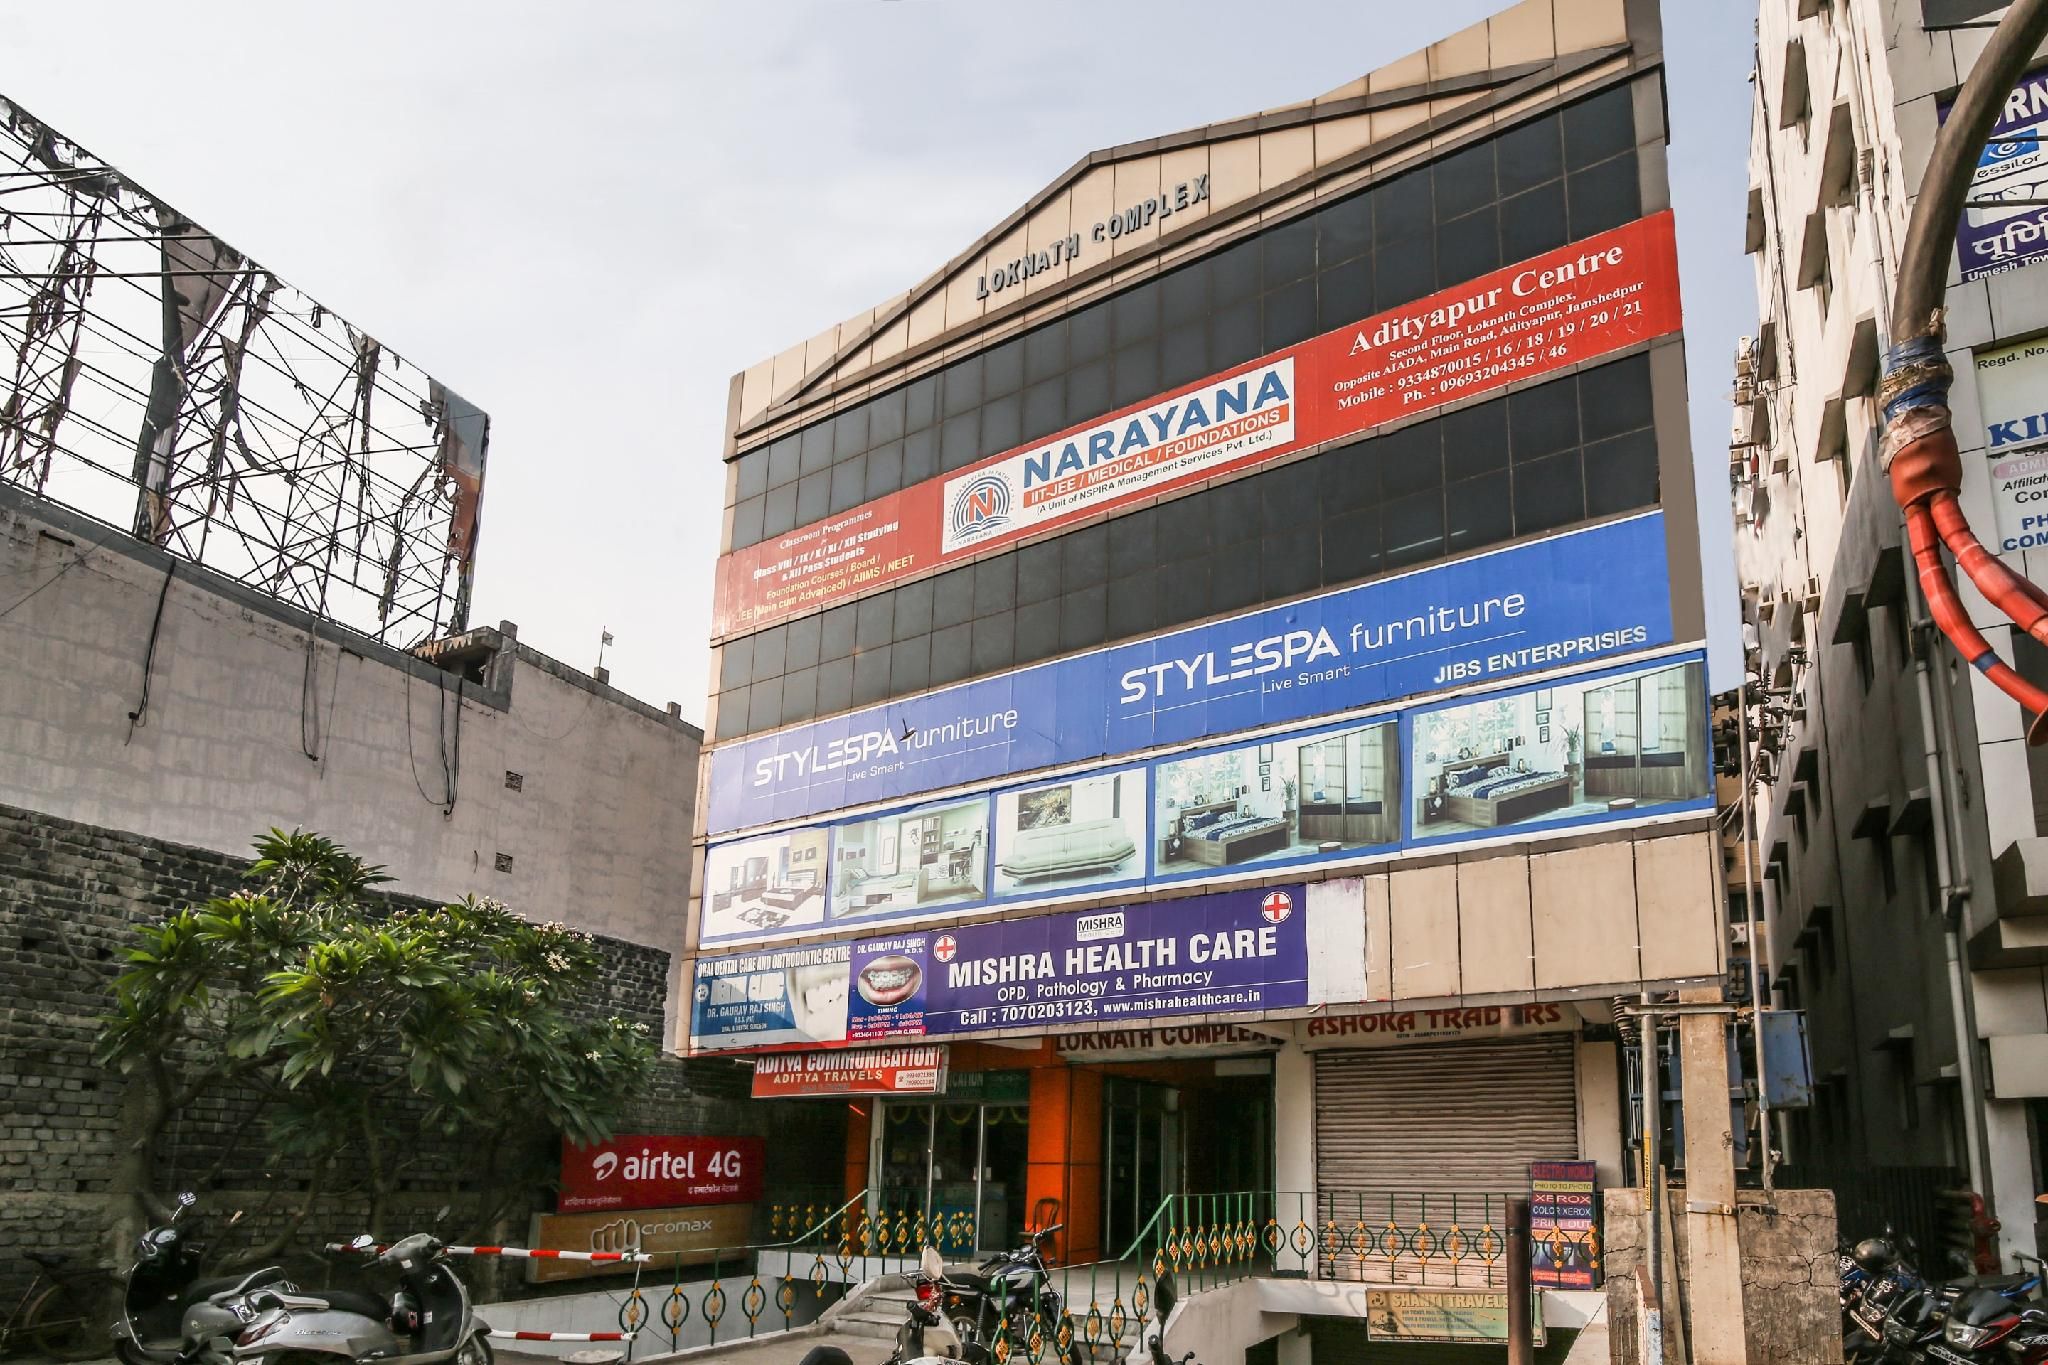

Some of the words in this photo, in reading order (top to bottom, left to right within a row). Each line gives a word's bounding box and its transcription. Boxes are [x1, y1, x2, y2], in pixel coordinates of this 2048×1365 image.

[1977, 153, 2041, 179] essilor
[976, 233, 1079, 300] LOKNATH
[1091, 173, 1209, 243] COMPLEX
[1967, 260, 2018, 282] Umesh
[1348, 286, 1503, 357] Adityapur
[1510, 244, 1624, 298] Centre
[1333, 369, 1381, 393] Opposite
[1430, 342, 1460, 359] Main
[1462, 331, 1498, 350] Road,
[1499, 310, 1563, 339] Adityapur,
[1565, 281, 1645, 315] Jamshedpur
[1389, 340, 1428, 361] Second
[1431, 330, 1464, 347] Floor,
[1467, 312, 1516, 335] Loknath
[1519, 292, 1577, 318] Complex,
[1336, 384, 1386, 411] Mobile
[1397, 353, 1482, 391] 9334870015
[1494, 342, 1512, 359] 16
[1526, 331, 1544, 347] 18
[1557, 321, 1576, 339] 19
[1589, 312, 1609, 329] 20
[1622, 299, 1642, 316] 21
[1977, 352, 2020, 370] Regd.
[1403, 388, 1427, 406] Ph.
[1439, 353, 1536, 392] 09693204345
[1547, 344, 1567, 359] 46
[1023, 369, 1290, 489] NARAYANA
[1988, 412, 2048, 448] KI
[1031, 480, 1076, 505] IIT-JEE
[1088, 457, 1153, 485] MEDICAL
[1165, 409, 1280, 456] FOUNDATIONS
[2008, 457, 2048, 475] ADMI
[1048, 496, 1067, 511] Unit
[1068, 493, 1078, 504] of
[1079, 480, 1115, 501] NSPIRA
[1117, 461, 1178, 489] Management
[1180, 447, 1223, 467] Services
[779, 529, 821, 550] Classroom
[822, 510, 873, 536] Programmes
[857, 520, 899, 544] Studying
[766, 580, 810, 600] Foundation
[811, 568, 844, 586] Courses
[851, 556, 876, 573] Board
[803, 561, 822, 578] Pass
[824, 546, 866, 568] Students
[778, 595, 797, 610] cum
[799, 578, 847, 602] Advanced)
[853, 565, 881, 585] AIIMS
[887, 554, 915, 573] NEET
[1119, 625, 1341, 705] STYLESPA
[1349, 592, 1526, 654] furniture
[1434, 656, 1482, 685] JIBS
[1487, 624, 1647, 675] ENTERPRISIES
[1261, 674, 1293, 696] Live
[1297, 662, 1351, 688] Smart
[753, 727, 898, 787] STYLESPA
[846, 769, 867, 783] Live
[869, 761, 904, 777] Smart
[1078, 915, 1123, 931] MISHRA
[949, 950, 1056, 989] MISHRA
[1065, 937, 1176, 977] HEALTH
[1189, 926, 1278, 962] CARE
[997, 986, 1030, 1003] OPD,
[1036, 979, 1108, 1001] Pathology
[1115, 976, 1125, 991] &
[1133, 969, 1213, 991] Pharmacy
[763, 999, 786, 1013] SINGH
[960, 1009, 988, 1026] Call
[1000, 1000, 1099, 1022] 7070203123,
[1103, 989, 1261, 1014] www.mishrahealthcare.in
[1307, 1011, 1416, 1037] ASHOKA
[1424, 1003, 1562, 1031] TRADRS
[756, 1055, 802, 1075] ADITYA
[806, 1046, 937, 1072] COMMUNICATION
[773, 1071, 819, 1084] ADITYA
[823, 1069, 883, 1083] TRAVELS
[623, 1148, 695, 1180] airtel
[707, 1150, 741, 1178] 4G
[1535, 1194, 1591, 1204] XEROX
[1562, 1207, 1591, 1216] XEROX
[1567, 1220, 1592, 1229] OUT
